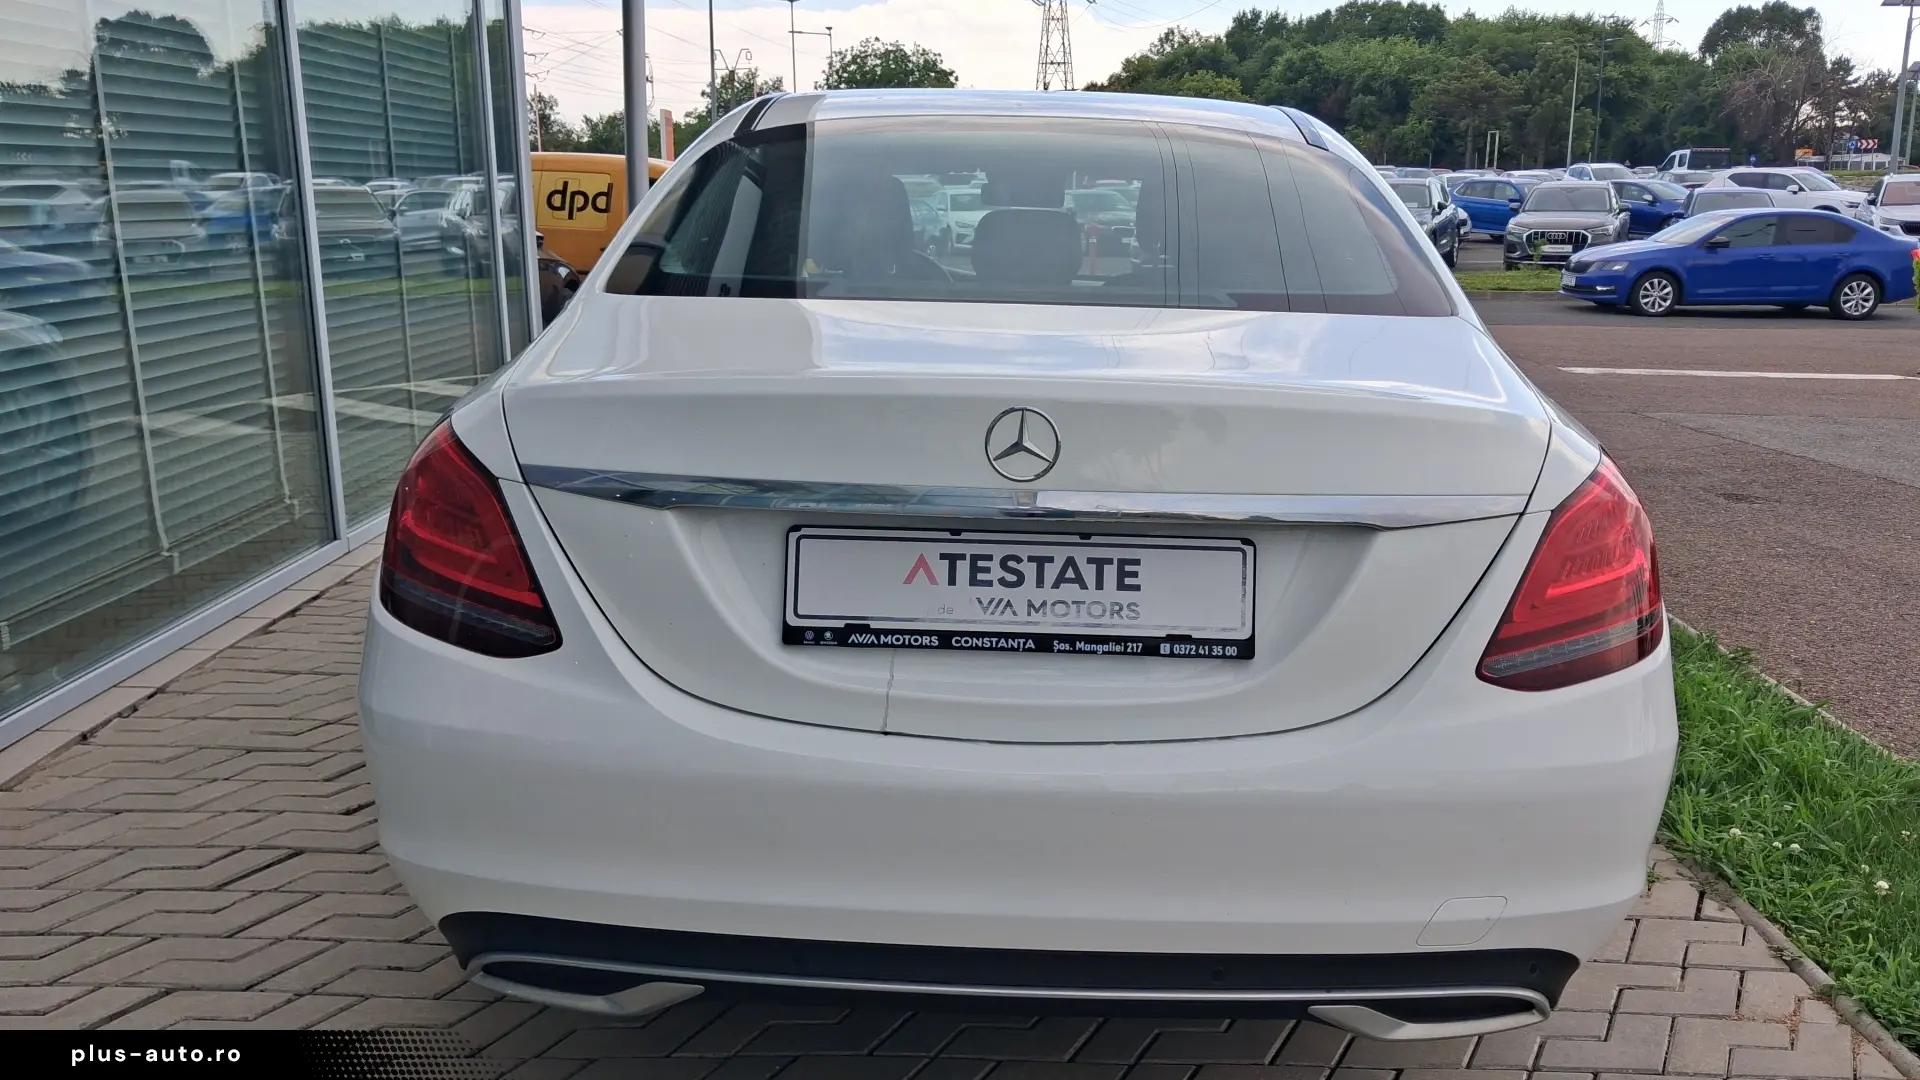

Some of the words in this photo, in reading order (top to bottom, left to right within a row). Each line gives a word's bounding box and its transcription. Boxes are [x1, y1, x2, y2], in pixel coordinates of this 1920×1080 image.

[546, 181, 613, 220] dpd
[902, 552, 1142, 592] ATESTATE
[1026, 598, 1141, 621] MOTORS
[880, 634, 939, 647] MOTORS
[1075, 641, 1125, 655] Mangaliei
[1126, 643, 1143, 653] 217
[1173, 644, 1197, 655] 0372
[1198, 645, 1209, 655] 41
[1211, 645, 1223, 656] 35
[1225, 646, 1238, 656] 00
